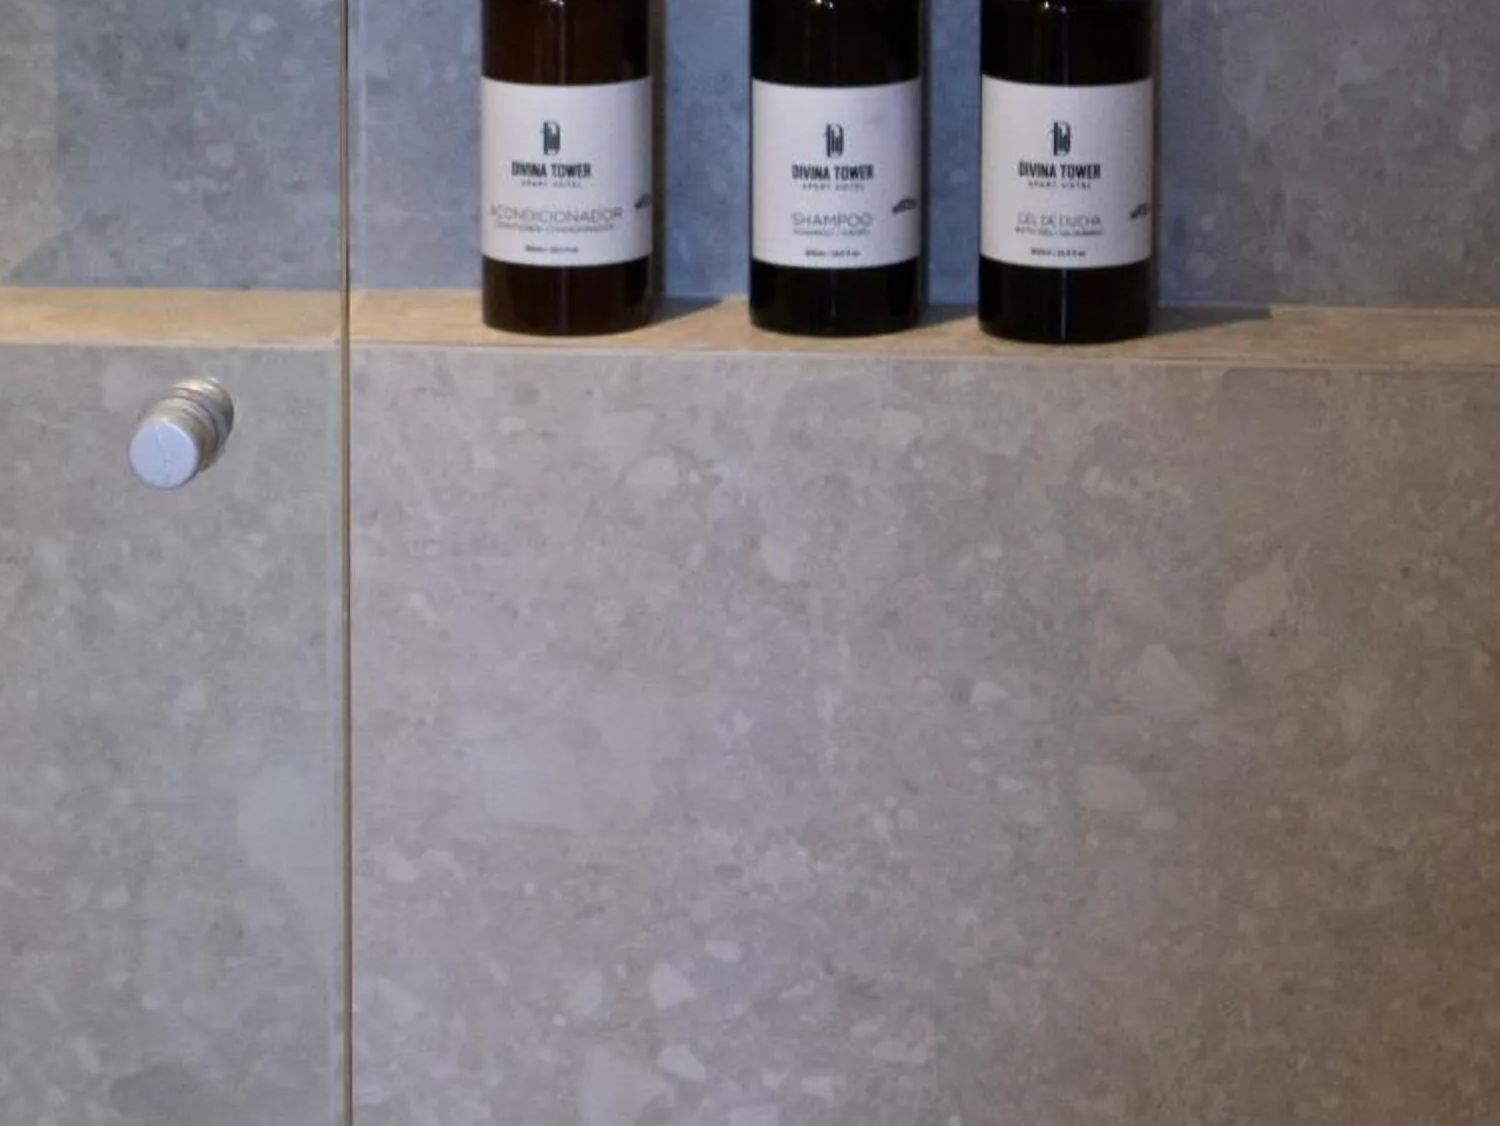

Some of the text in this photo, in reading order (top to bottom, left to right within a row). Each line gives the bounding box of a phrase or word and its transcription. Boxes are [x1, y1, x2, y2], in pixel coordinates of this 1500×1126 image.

[511, 161, 592, 179] DIVINA TOWER
[791, 164, 875, 180] DIVINA TOWER
[1018, 160, 1102, 179] DIVINA TOWER
[791, 212, 873, 227] SHAMPOO
